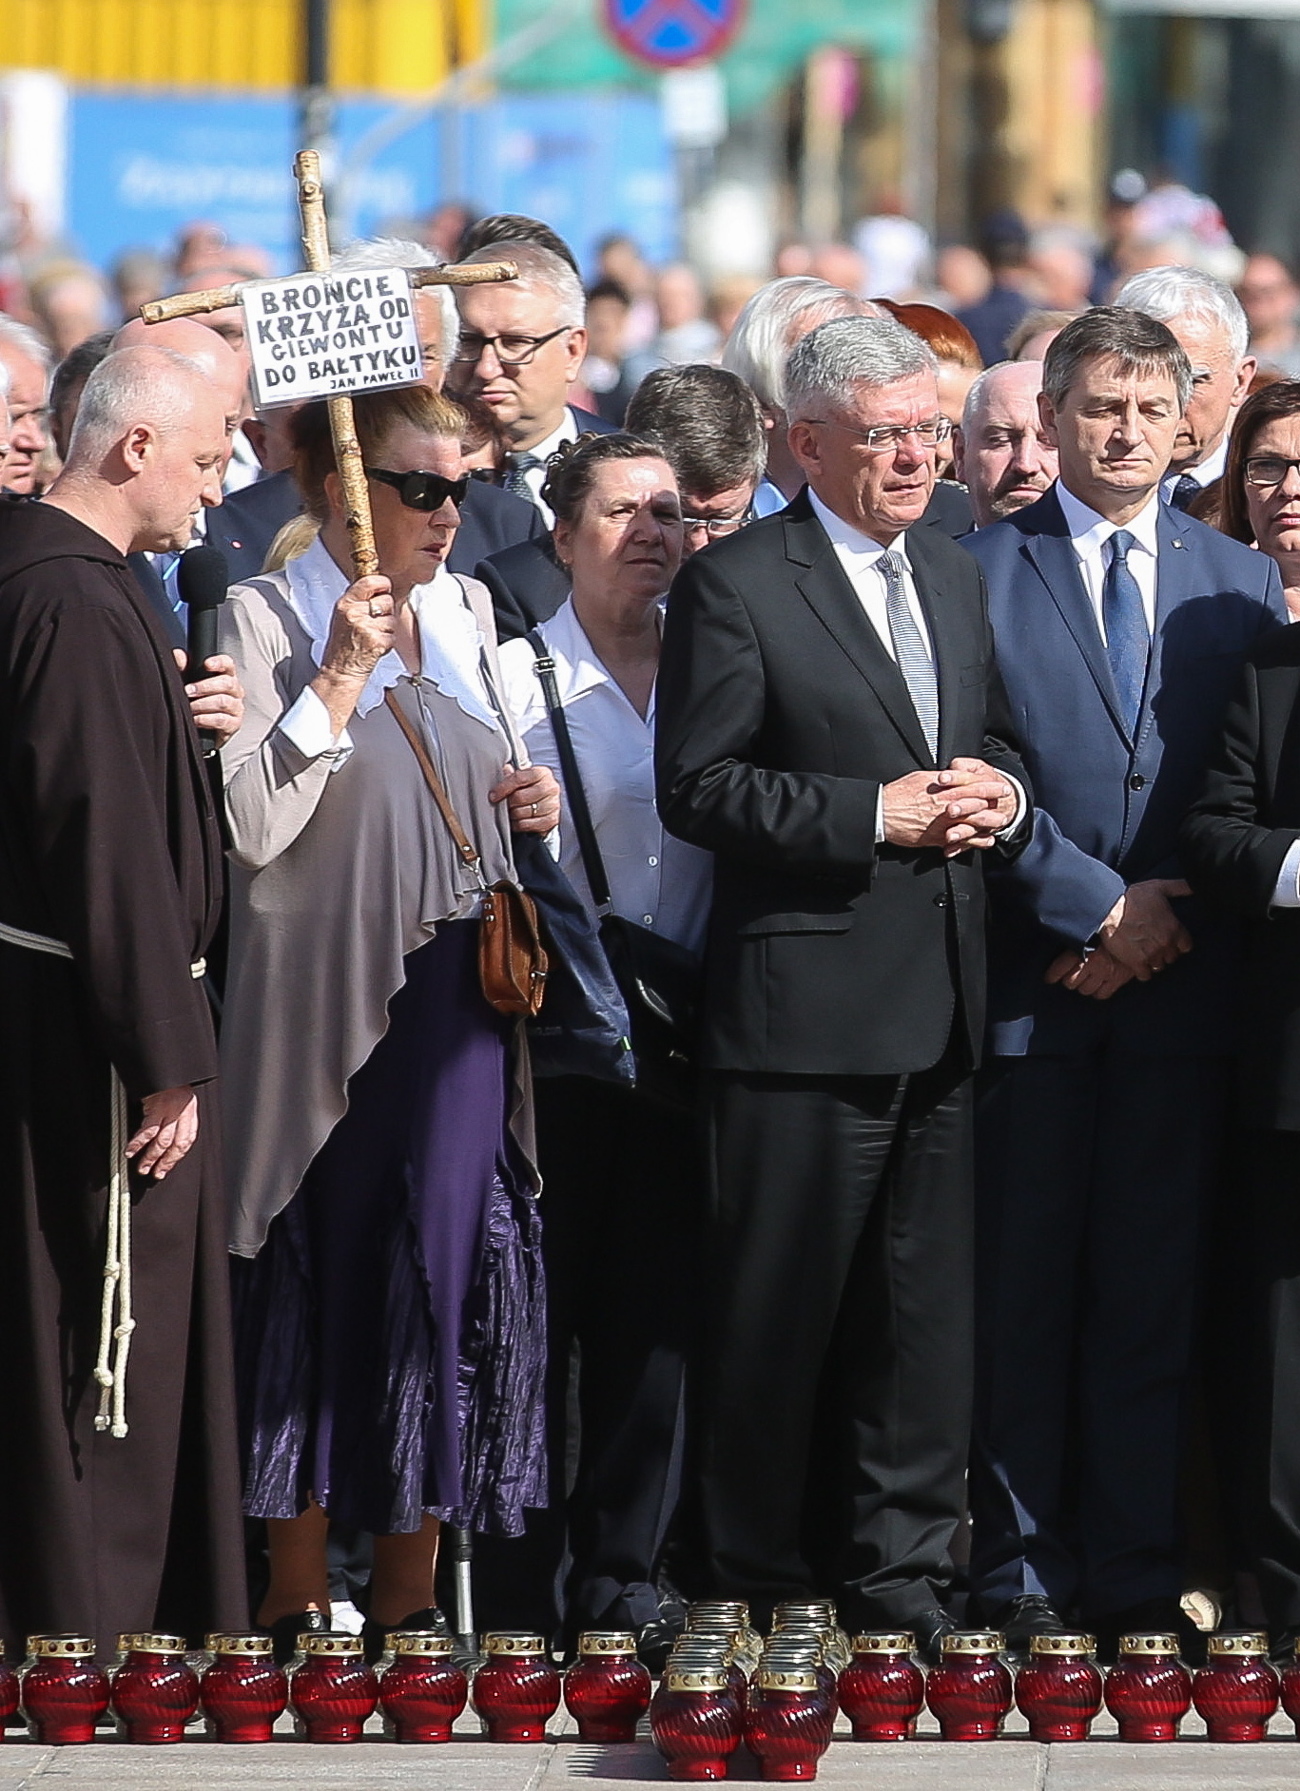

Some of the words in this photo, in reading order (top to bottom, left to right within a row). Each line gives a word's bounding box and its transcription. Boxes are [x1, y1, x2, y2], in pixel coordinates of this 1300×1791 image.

[257, 304, 370, 344] KRZYŻA
[379, 297, 410, 320] OD
[271, 321, 403, 361] GIEWONTU
[264, 364, 296, 388] DO
[308, 345, 417, 380] BAŁTYKU
[330, 377, 357, 390] JAN
[363, 371, 404, 385] PAWEŁ
[410, 368, 419, 379] II
